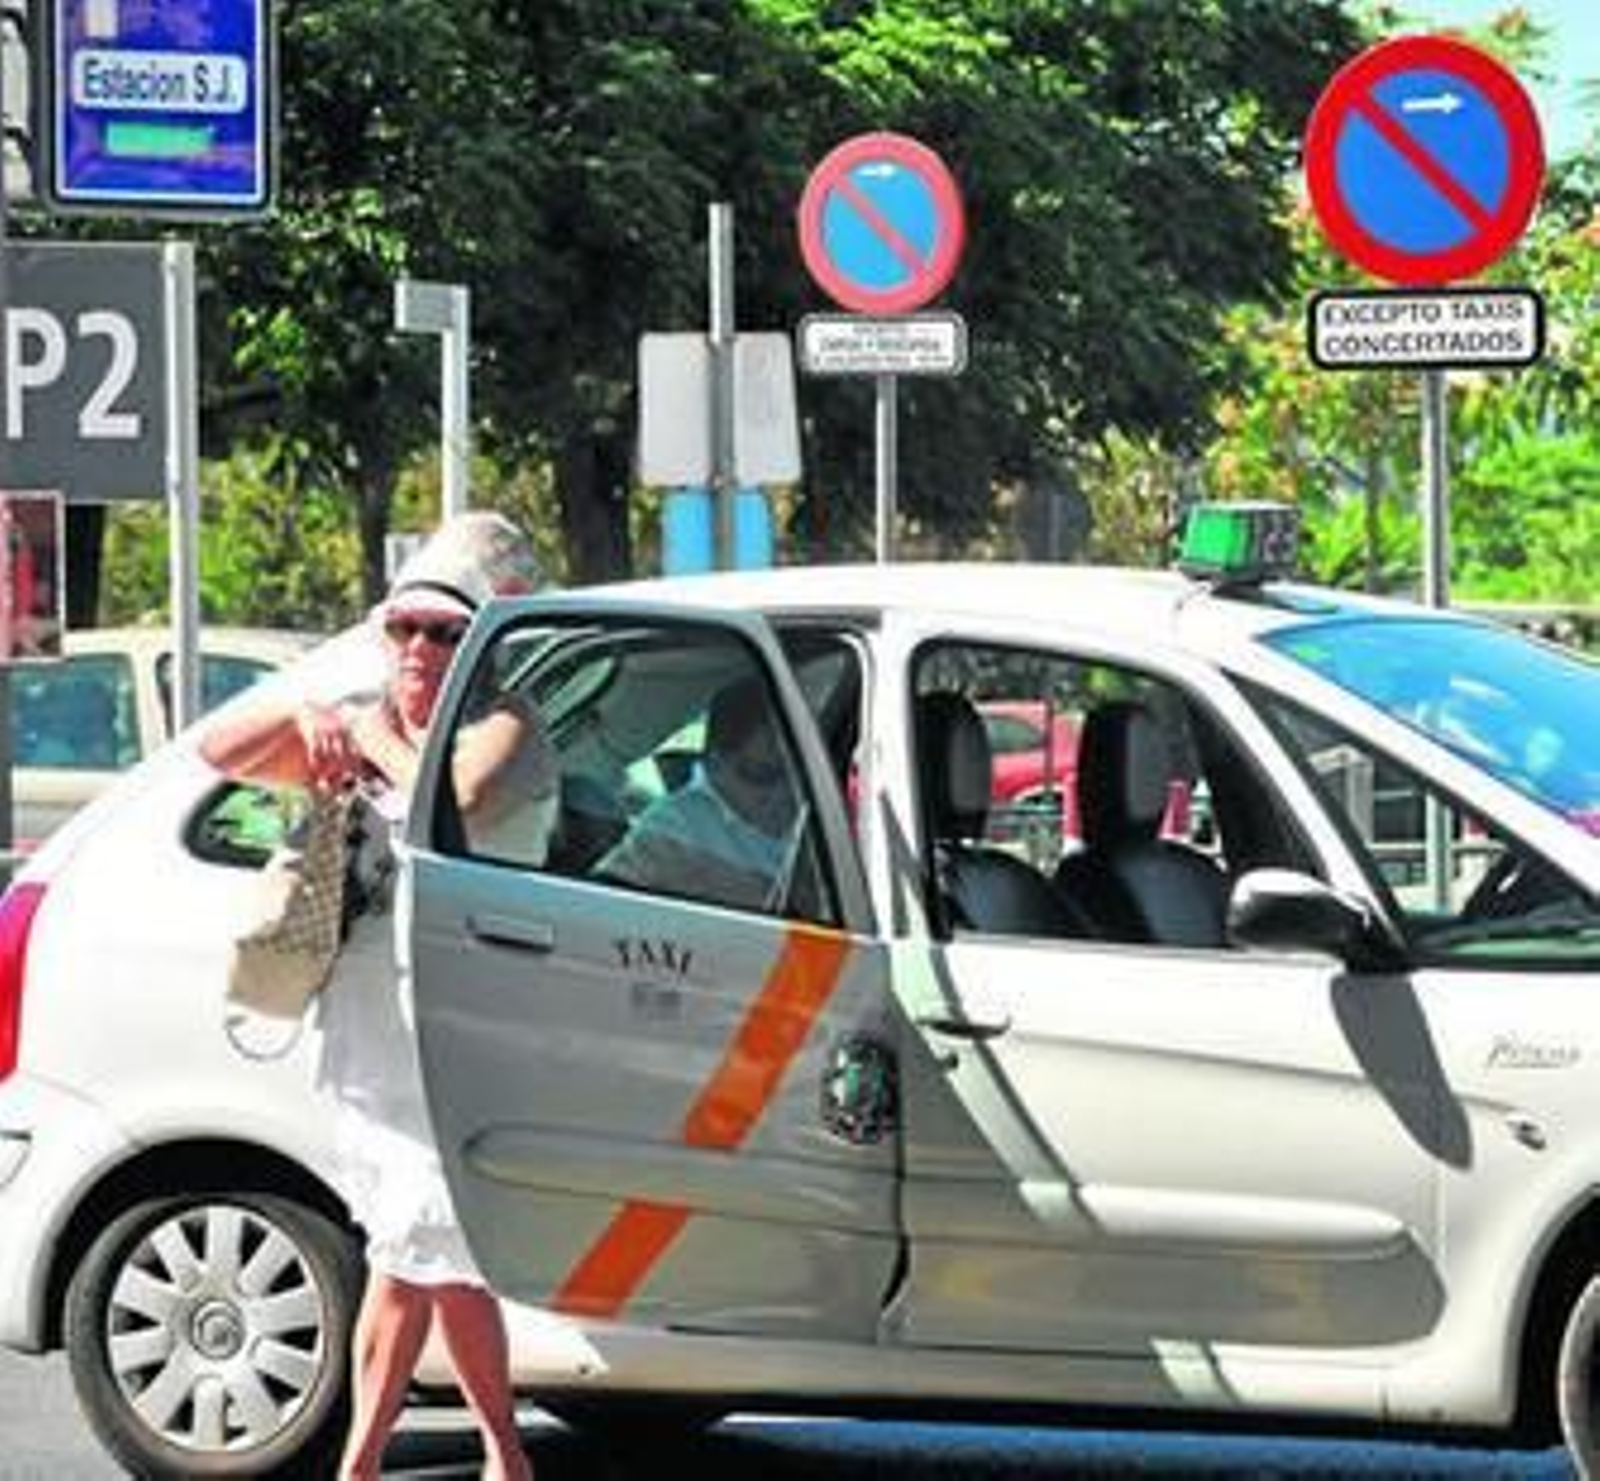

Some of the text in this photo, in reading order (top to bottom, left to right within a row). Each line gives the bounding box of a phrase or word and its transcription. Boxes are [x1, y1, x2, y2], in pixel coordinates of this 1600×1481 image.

[1323, 300, 1524, 326] EXCEPTO TAXIS
[1324, 331, 1524, 357] CONCERTADOS
[5, 307, 141, 440] P2
[612, 938, 695, 974] TAXI
